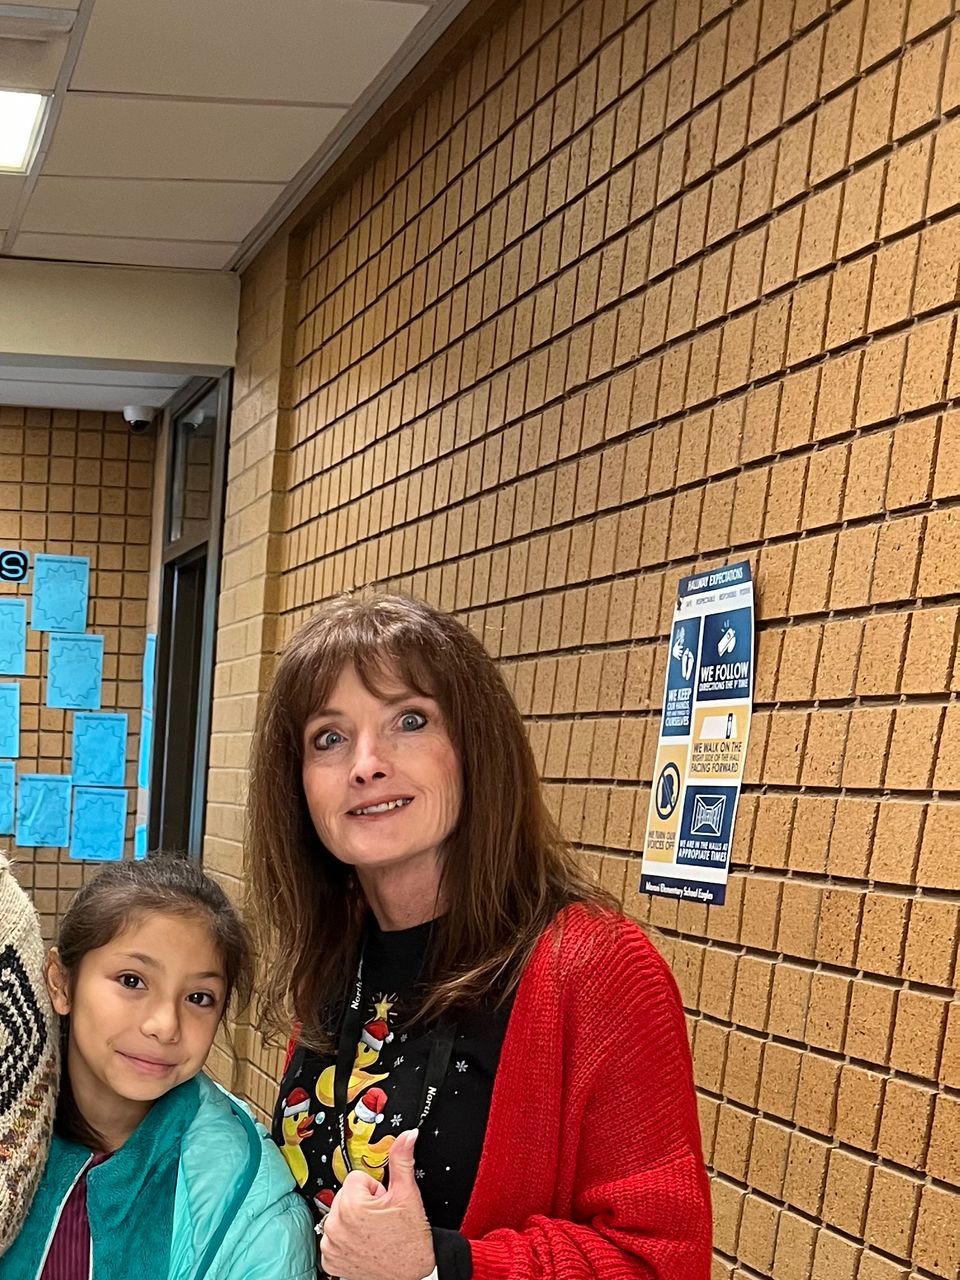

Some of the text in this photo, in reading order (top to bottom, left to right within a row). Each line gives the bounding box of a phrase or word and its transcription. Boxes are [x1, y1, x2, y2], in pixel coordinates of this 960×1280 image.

[709, 567, 743, 586] EXPECTATIONS
[701, 662, 749, 682] WE FOLLOW
[699, 681, 724, 692] DIRECTIONS
[668, 688, 692, 701] WE KEEP
[667, 702, 675, 710] OUR
[693, 742, 742, 753] WE WALK ON THE
[691, 762, 738, 772] FACING FORWARD
[656, 831, 665, 839] TURN
[666, 832, 676, 840] OUR
[648, 840, 674, 850] VOICES OFF
[710, 851, 727, 862] TIMES
[660, 883, 683, 898] Elementary
[683, 886, 698, 897] School
[698, 888, 713, 901] Eagles
[350, 981, 362, 1010] North
